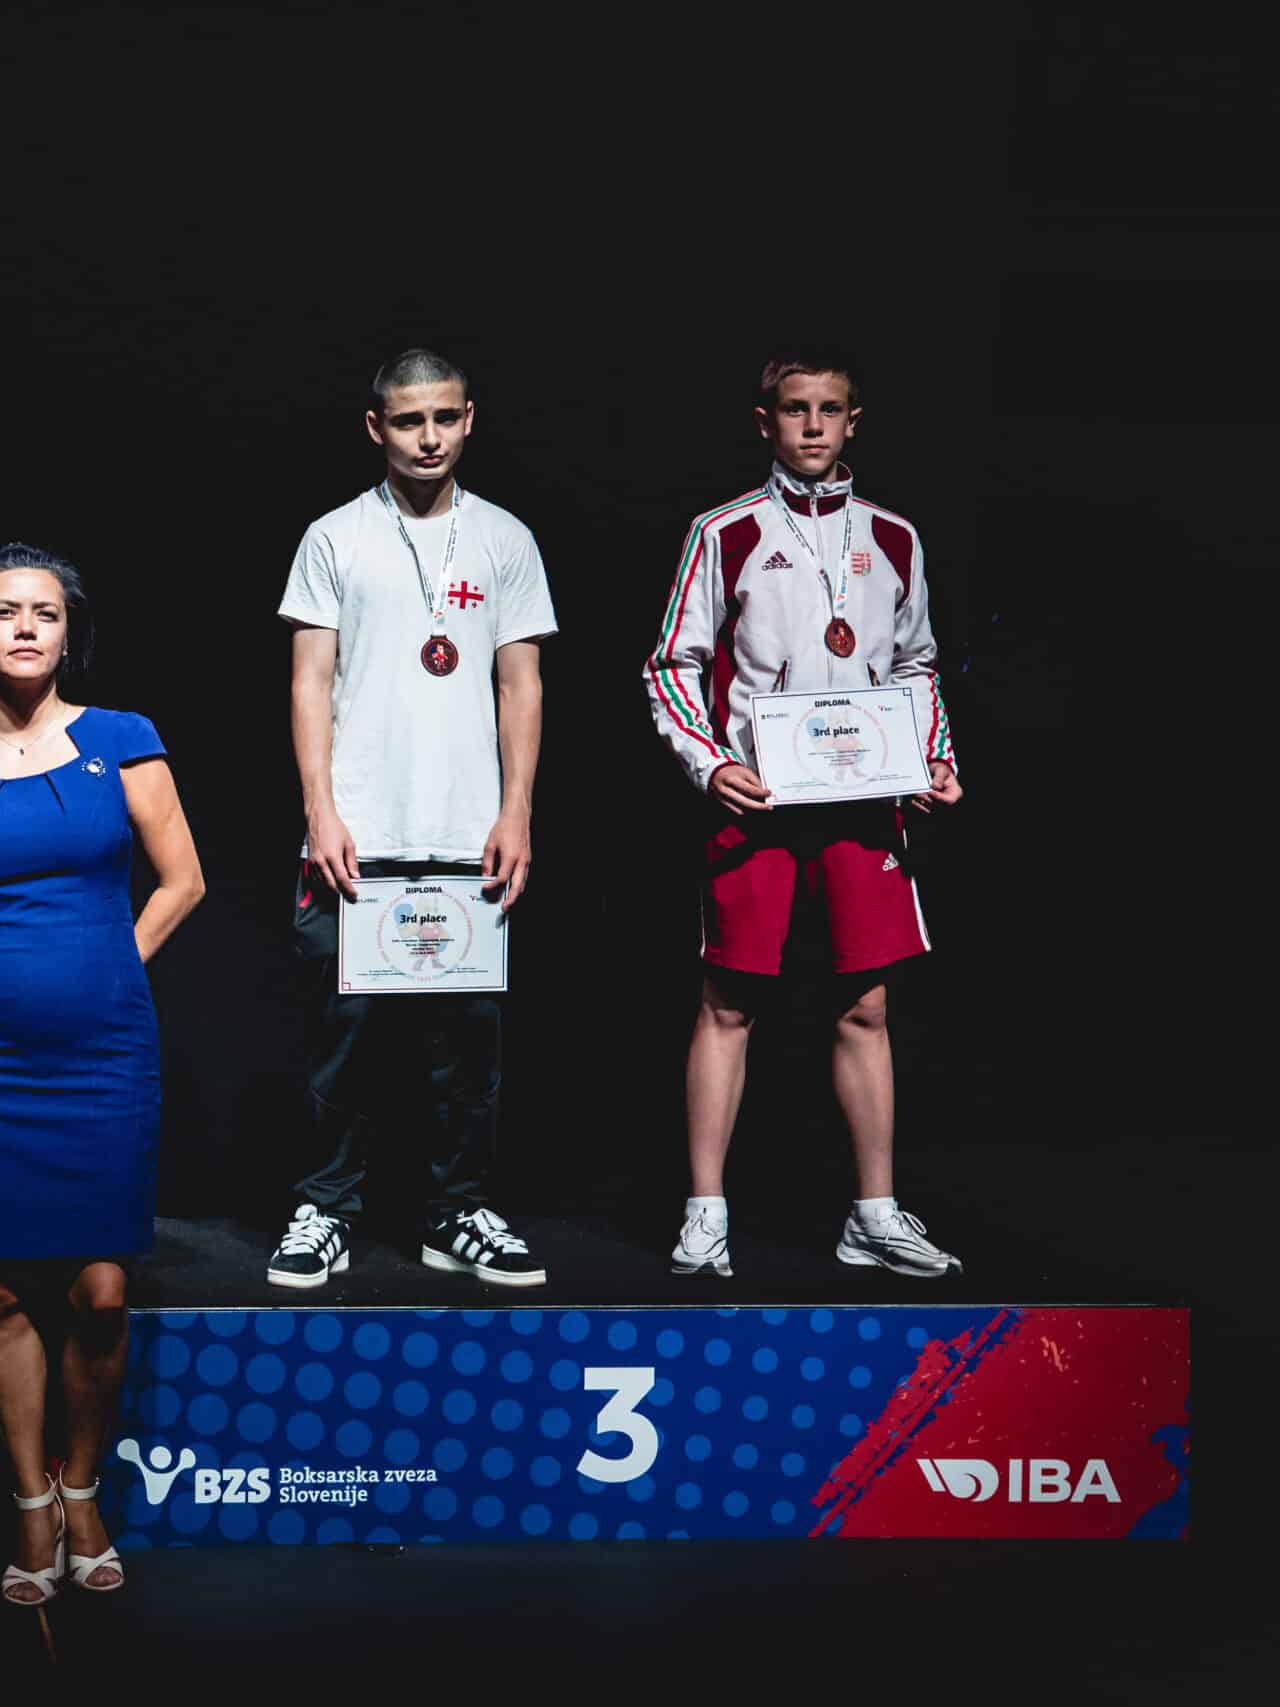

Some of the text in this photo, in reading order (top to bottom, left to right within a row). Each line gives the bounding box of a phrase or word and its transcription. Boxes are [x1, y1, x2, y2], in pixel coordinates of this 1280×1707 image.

[814, 698, 851, 708] DIPLOMA
[813, 726, 860, 738] 3rd place
[405, 886, 443, 895] DIPLOMA
[399, 913, 448, 926] 3rd place
[576, 1366, 659, 1483] 3
[279, 1466, 438, 1484] Boksarska zveza
[1008, 1459, 1122, 1503] IBA
[195, 1467, 271, 1504] BZS
[279, 1485, 369, 1507] Slovenije
